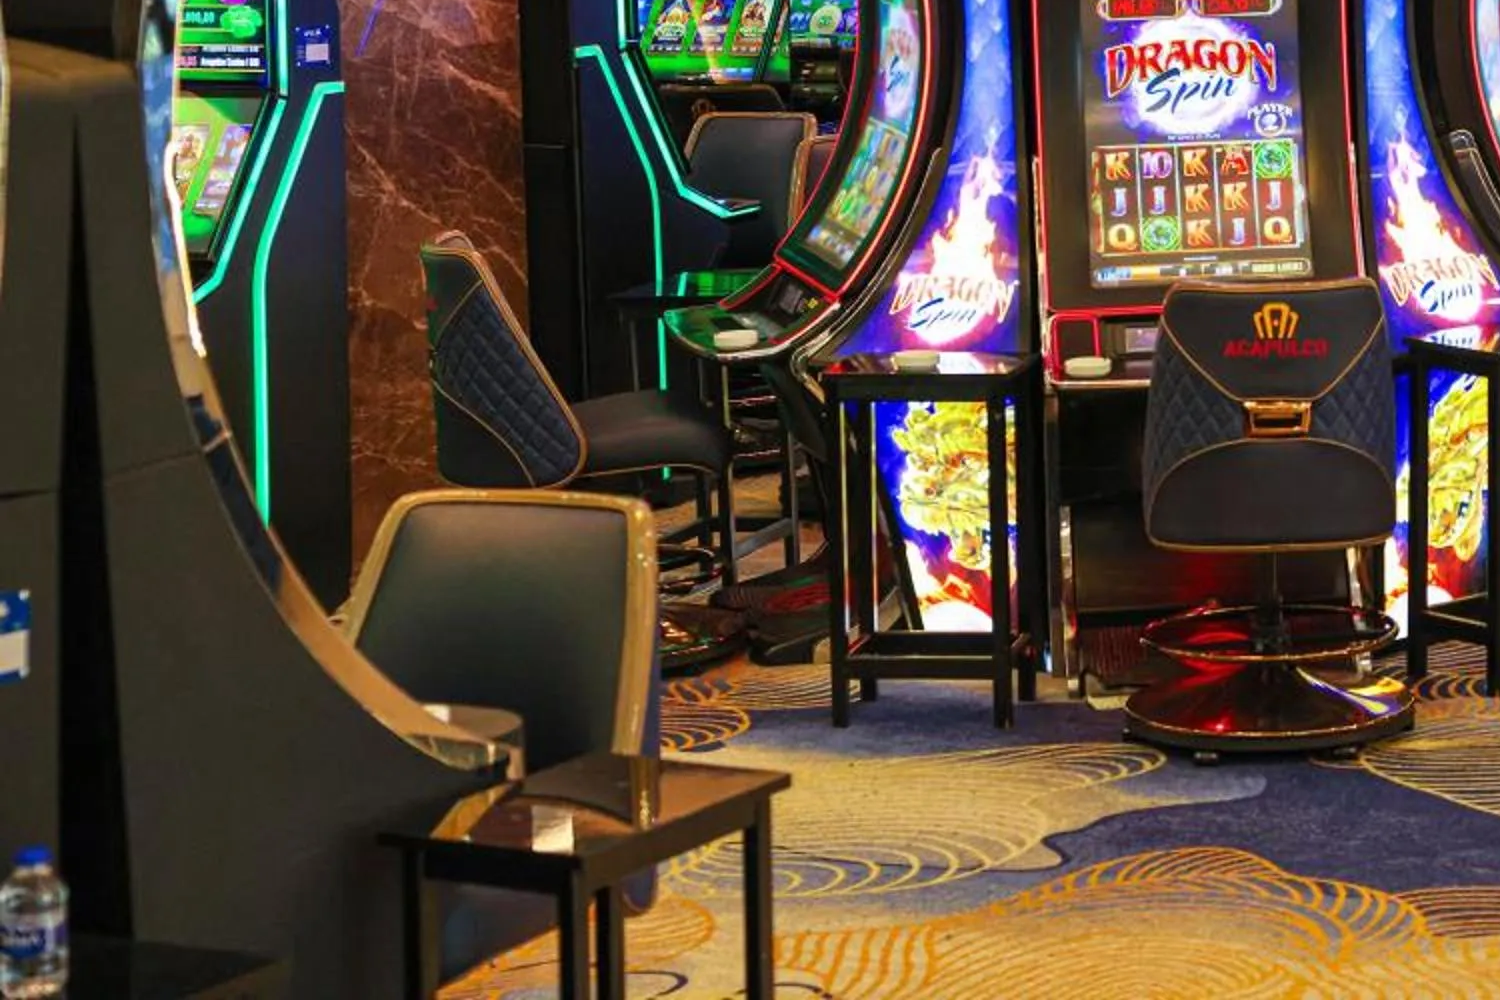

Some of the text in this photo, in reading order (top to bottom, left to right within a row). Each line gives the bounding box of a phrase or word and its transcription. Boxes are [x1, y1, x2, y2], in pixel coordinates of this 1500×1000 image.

[1104, 39, 1277, 98] DRAGON
[1145, 67, 1238, 114] Spin
[1140, 150, 1174, 179] 10
